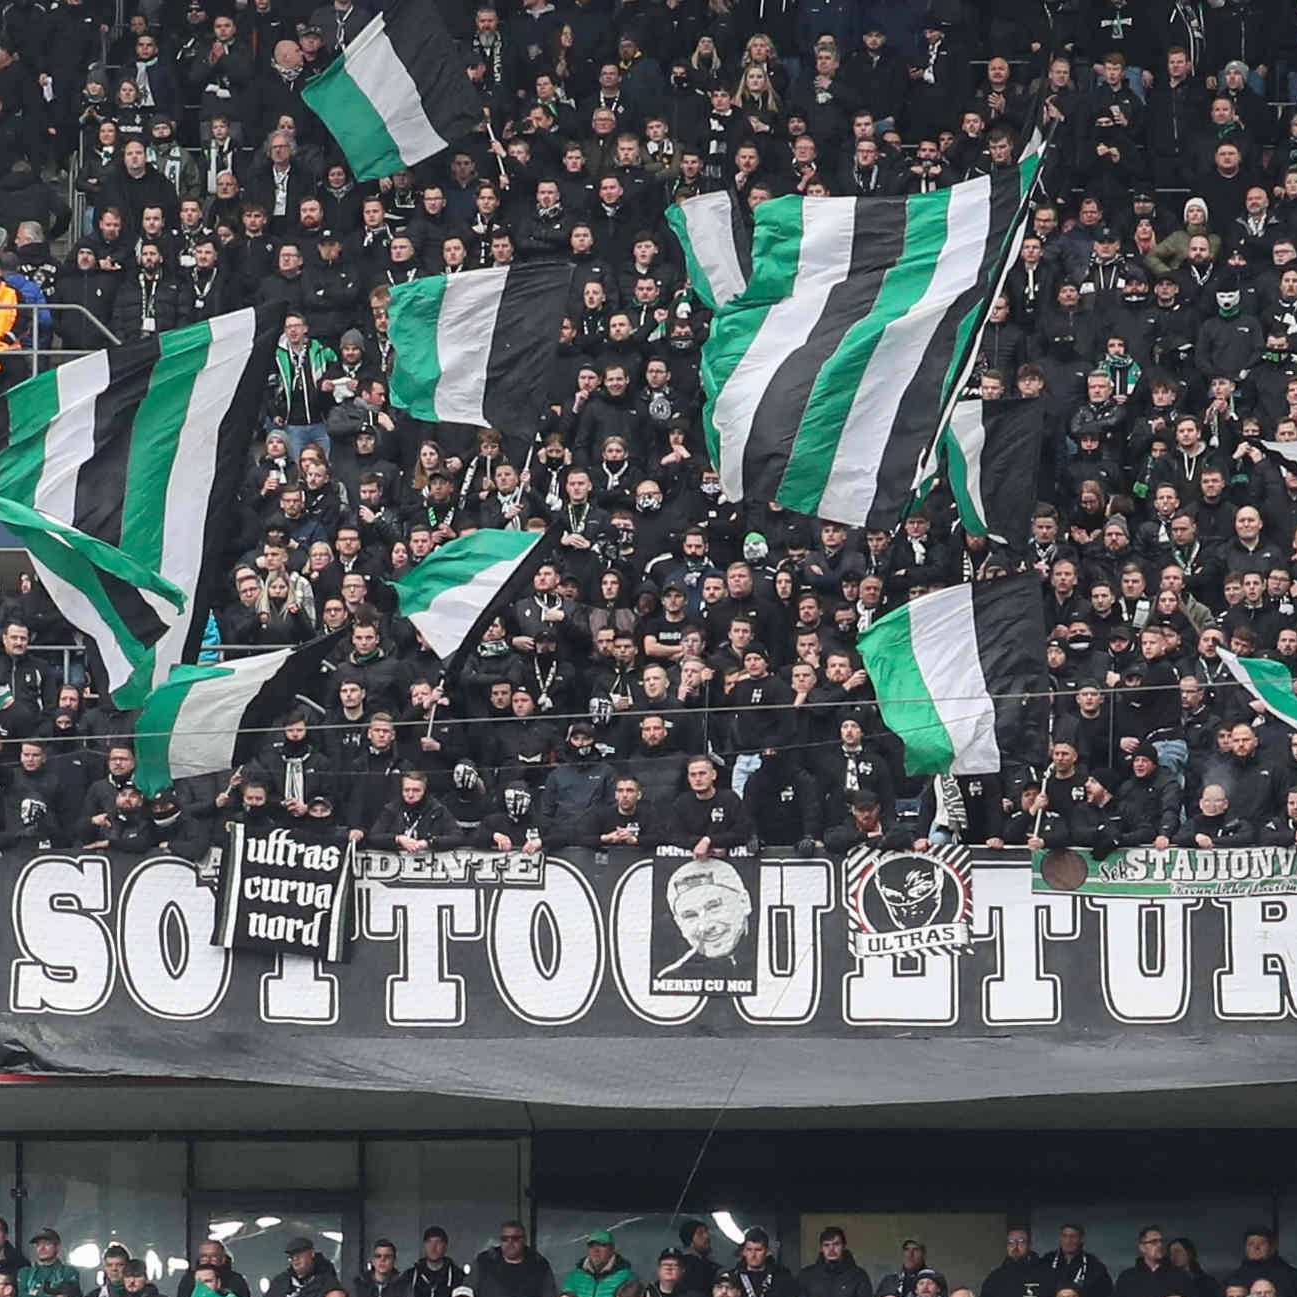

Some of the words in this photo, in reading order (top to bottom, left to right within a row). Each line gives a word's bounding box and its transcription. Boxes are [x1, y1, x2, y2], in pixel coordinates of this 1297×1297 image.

[246, 828, 341, 871] ultras
[244, 875, 333, 909] curva
[248, 910, 328, 947] nord
[867, 927, 956, 952] ULTRAS
